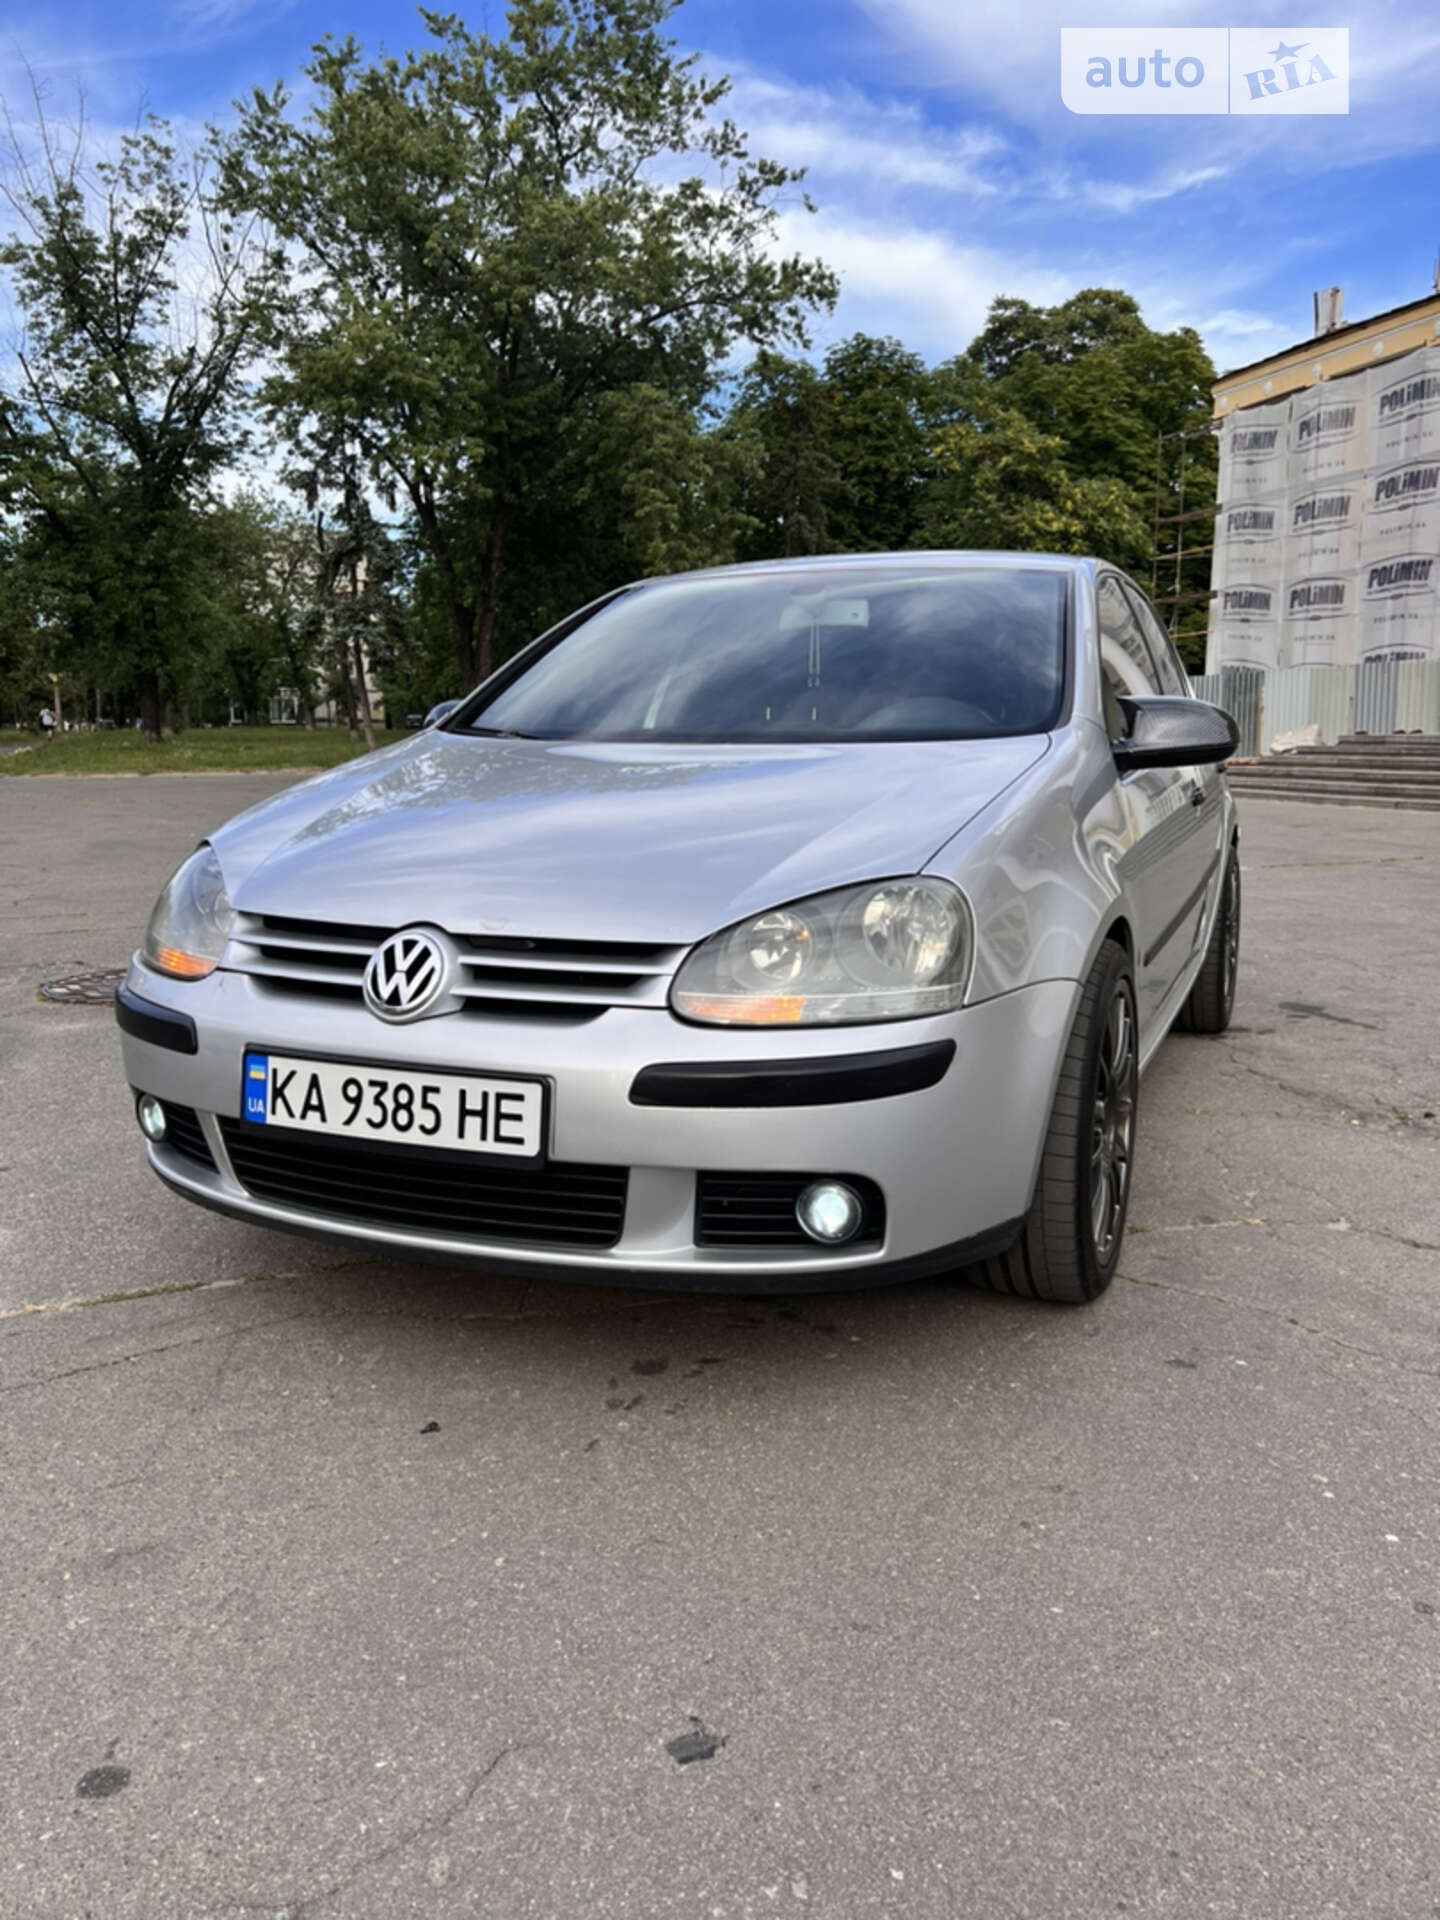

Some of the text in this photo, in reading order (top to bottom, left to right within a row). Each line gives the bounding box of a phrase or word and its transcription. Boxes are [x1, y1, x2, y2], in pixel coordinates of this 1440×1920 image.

[247, 1098, 265, 1114] UA
[271, 1067, 525, 1146] KA 9385 HE
